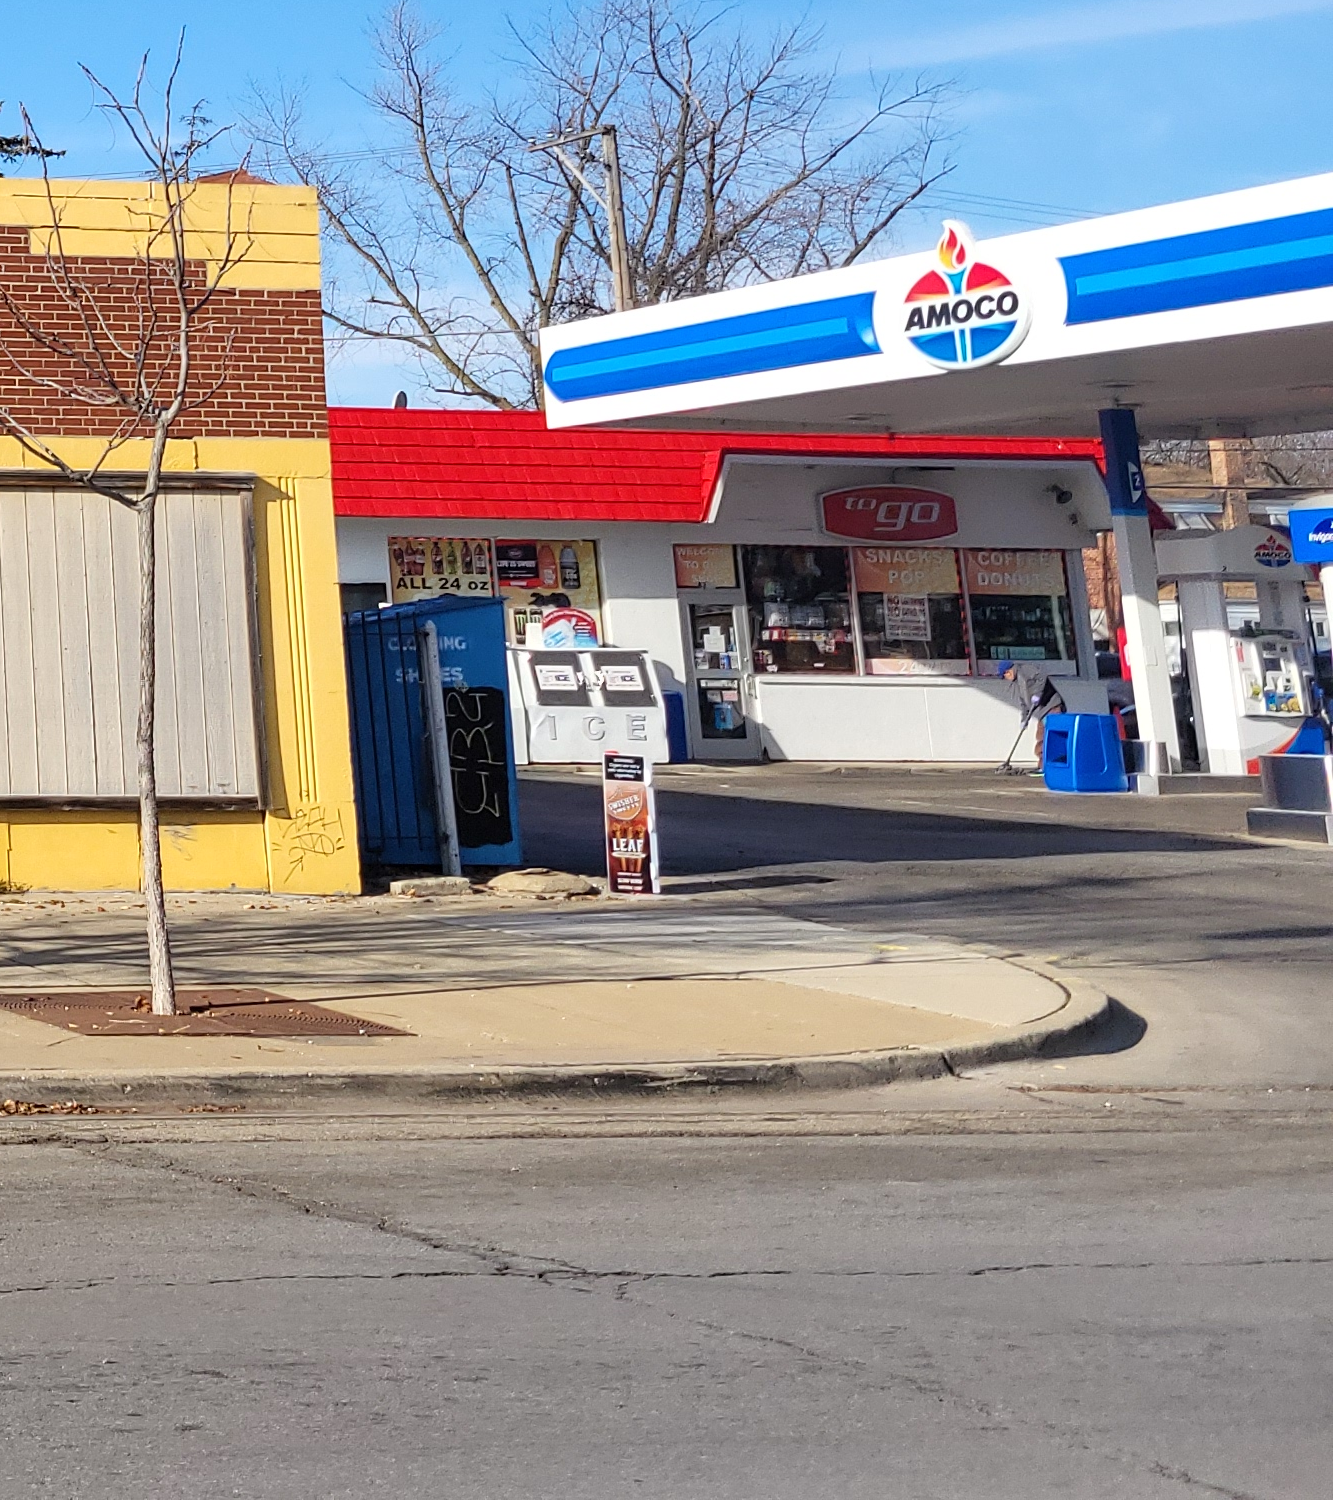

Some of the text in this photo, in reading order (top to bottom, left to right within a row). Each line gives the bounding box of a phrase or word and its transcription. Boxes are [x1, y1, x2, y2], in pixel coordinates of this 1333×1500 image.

[904, 290, 1019, 332] AMOCO
[845, 497, 941, 531] to go
[866, 549, 942, 564] SNACKS
[1254, 551, 1292, 560] AMOCO
[396, 577, 489, 590] ALL 24 oz
[888, 570, 925, 584] POP
[395, 667, 464, 683] SHES
[546, 713, 648, 741] ICE
[612, 837, 644, 852] LEAF
